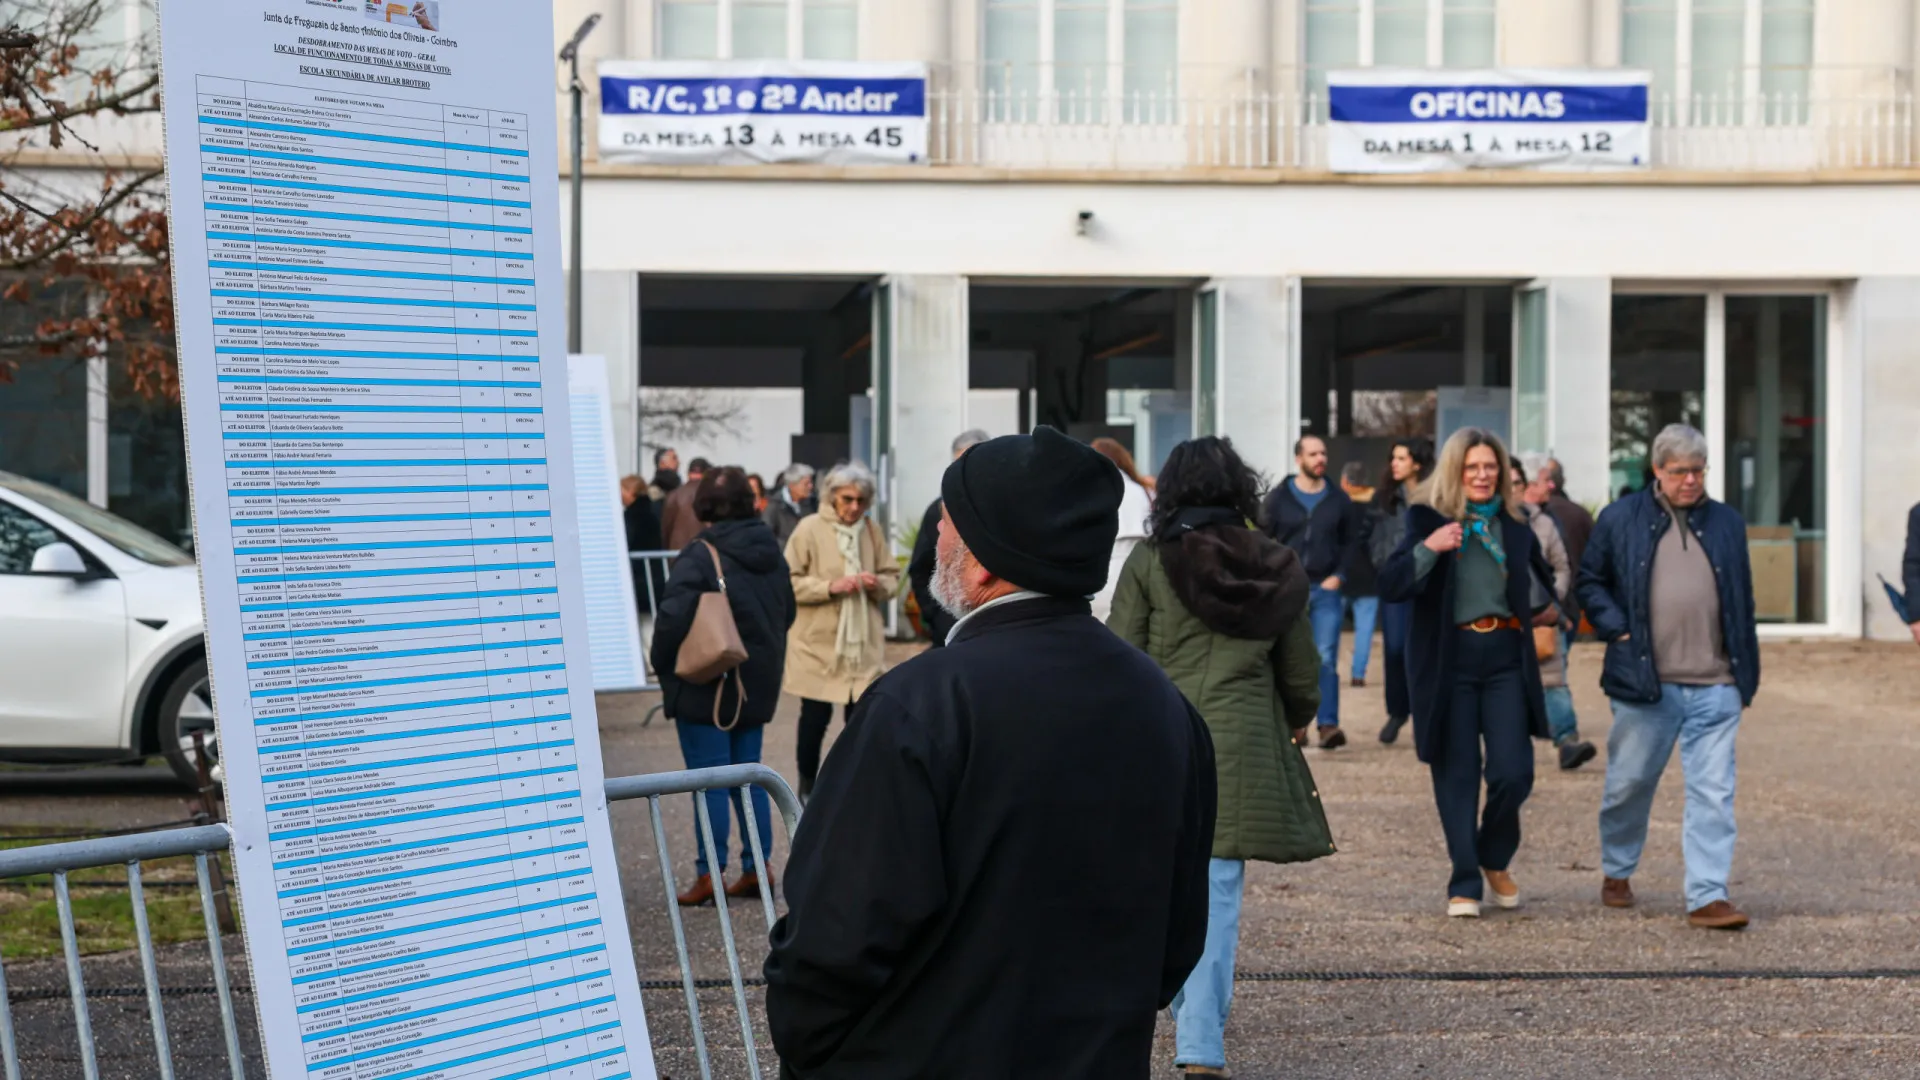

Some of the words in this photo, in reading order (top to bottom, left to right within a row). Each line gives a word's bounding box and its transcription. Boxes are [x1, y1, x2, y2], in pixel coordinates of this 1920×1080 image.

[263, 11, 282, 23] Junta
[283, 14, 293, 24] de
[293, 15, 328, 29] Freguesia
[329, 20, 339, 31] de
[339, 22, 359, 34] Santo
[360, 25, 388, 38] António
[389, 29, 402, 40] dos
[402, 31, 425, 43] Olivais
[430, 34, 457, 47] Coimbra
[273, 43, 297, 54] LOCAL
[296, 46, 307, 56] DE
[306, 47, 363, 63] FUNCIONAMENTO
[362, 55, 372, 64] DE
[371, 56, 393, 66] TODAS
[393, 59, 402, 68] AS
[401, 60, 423, 70] MESAS
[423, 63, 431, 71] DE
[432, 64, 451, 74] VOTO:
[297, 36, 352, 50] DESDOBRAMENTO
[353, 43, 365, 52] DAS
[366, 45, 386, 55] MESAS
[386, 48, 395, 56] DE
[396, 49, 412, 58] VOTO
[417, 52, 436, 62] GERAL
[299, 64, 325, 76] ESCOLA
[324, 68, 366, 81] SECUNDÁRIA
[365, 73, 375, 82] DE
[374, 75, 401, 85] AVELAR
[400, 77, 430, 88] BROTERO
[628, 85, 696, 114] R/C,
[736, 90, 756, 110] e
[800, 86, 899, 112] Andar
[1409, 91, 1565, 118] OFICINAS
[623, 133, 650, 146] DA
[657, 132, 713, 146] MESA
[723, 125, 754, 146] 13
[800, 132, 856, 146] MESA
[864, 127, 903, 146] 45
[1364, 139, 1391, 154] DA
[1399, 138, 1454, 153] MESA
[1463, 134, 1474, 152] 1
[1516, 138, 1572, 152] MESA
[1580, 133, 1612, 152] 12
